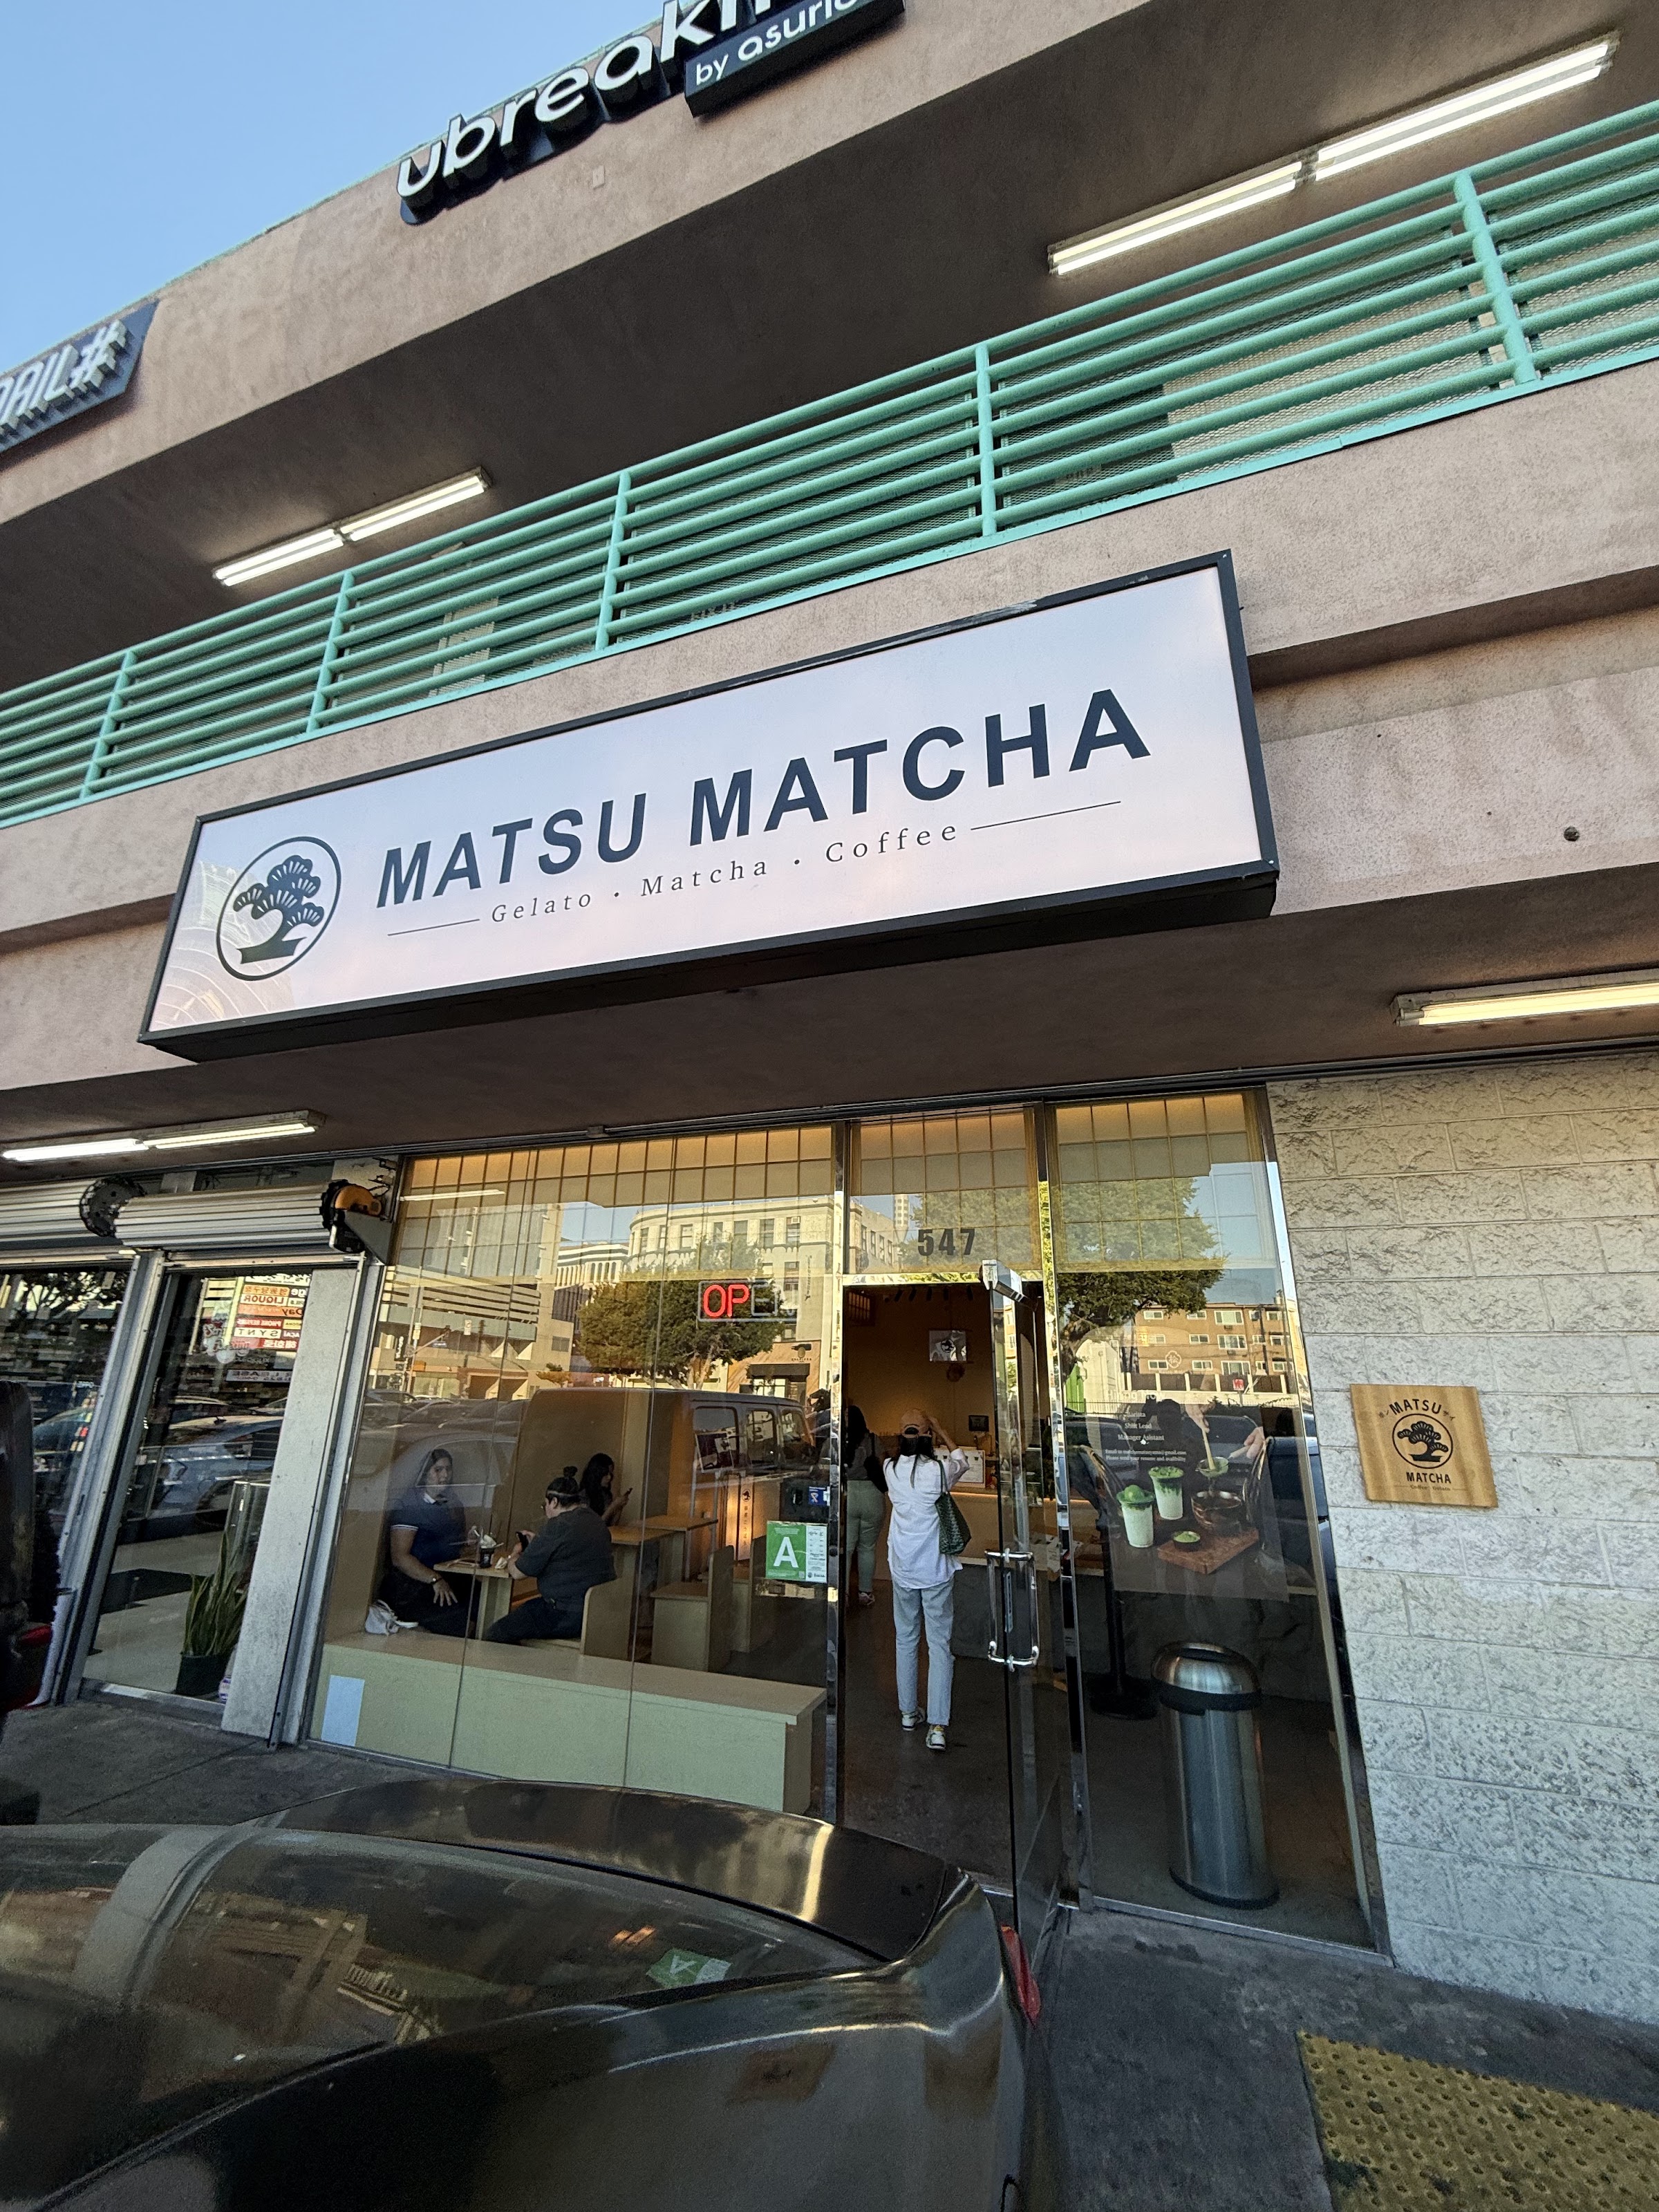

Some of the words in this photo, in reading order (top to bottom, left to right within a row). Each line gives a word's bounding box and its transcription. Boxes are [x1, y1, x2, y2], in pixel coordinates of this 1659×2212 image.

[696, 53, 729, 86] by
[375, 793, 647, 908] MATSU
[690, 688, 1151, 847] MATCHA
[491, 892, 592, 922] Gelato
[641, 859, 767, 897] Matcha
[825, 824, 957, 862] Coffee
[917, 1228, 975, 1257] 547
[1389, 1398, 1442, 1415] MATSU
[1117, 1434, 1141, 1442] Manager
[1406, 1472, 1452, 1484] MATCHA
[773, 1536, 799, 1568] A
